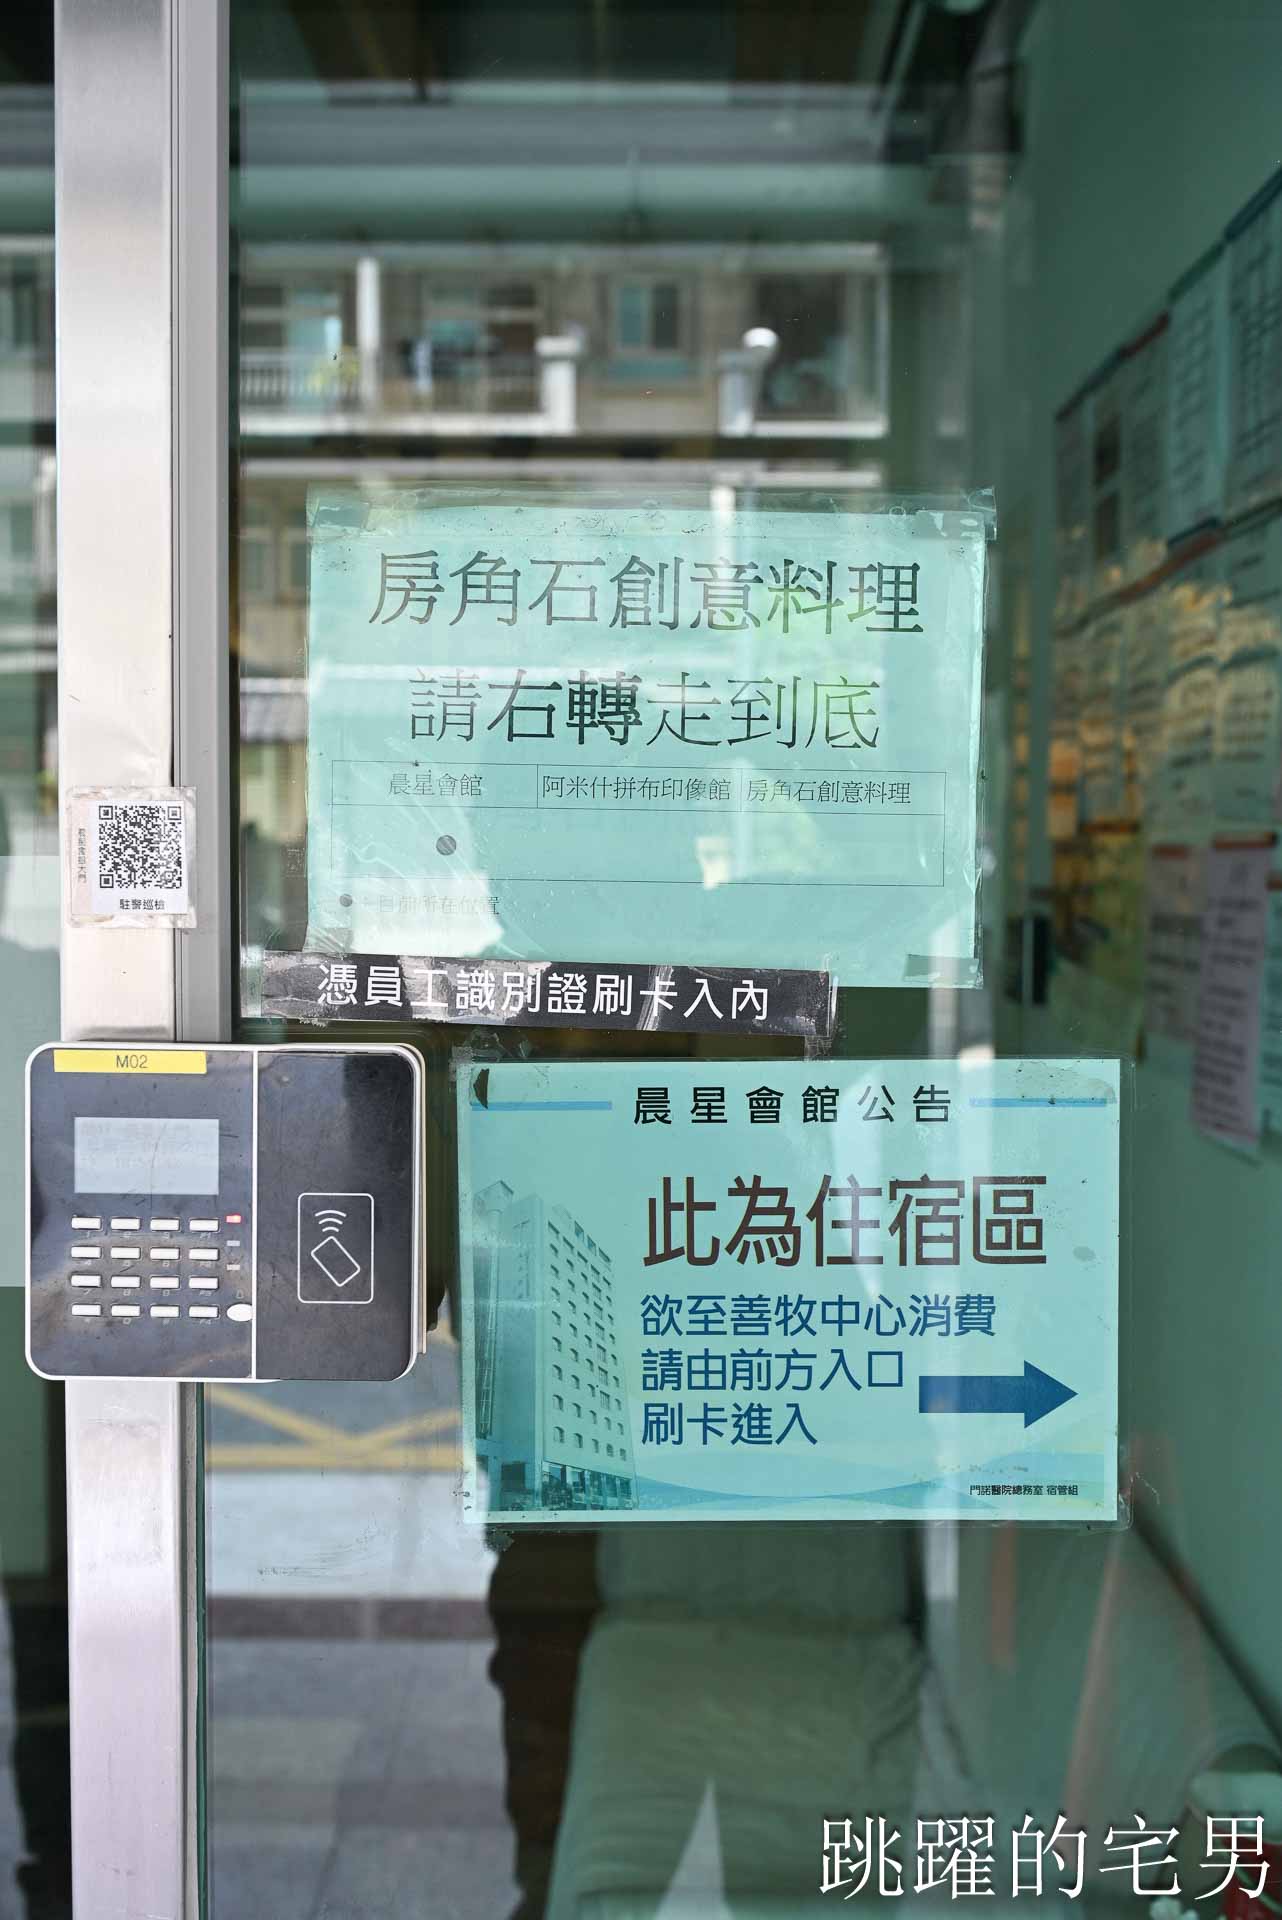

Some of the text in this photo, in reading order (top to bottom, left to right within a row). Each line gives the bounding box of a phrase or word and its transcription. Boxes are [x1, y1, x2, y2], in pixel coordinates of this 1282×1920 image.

[367, 548, 925, 635] 房角石創意料理
[408, 667, 882, 750] 請右轉走到底
[387, 772, 483, 798] 晨星會館
[541, 774, 731, 802] 阿米什拼布印像館
[746, 778, 912, 805] 房角石創意料理
[317, 963, 769, 1022] 憑員工識別證刷卡入內
[116, 1054, 149, 1069] M02
[633, 1084, 953, 1126] 晨星會館公告
[643, 1173, 1048, 1268] 此為住宿區
[641, 1292, 998, 1338] 欲至善牧中心消費
[641, 1347, 904, 1391] 請由前方入口
[641, 1402, 818, 1446] 刷卡進入
